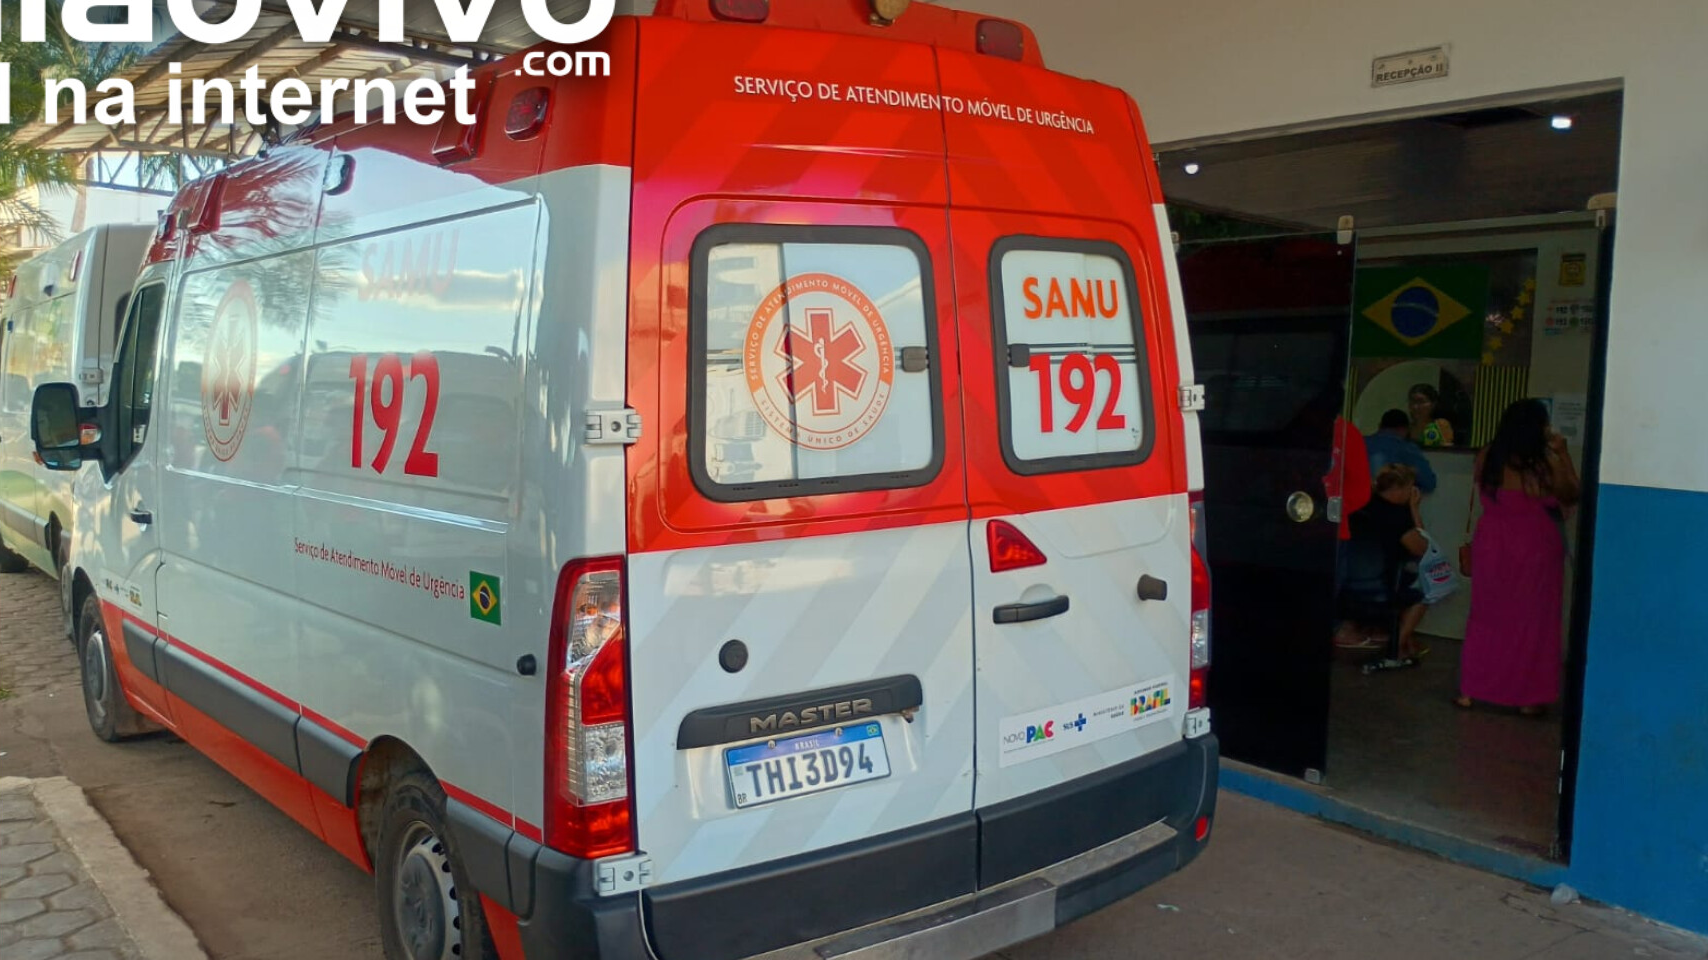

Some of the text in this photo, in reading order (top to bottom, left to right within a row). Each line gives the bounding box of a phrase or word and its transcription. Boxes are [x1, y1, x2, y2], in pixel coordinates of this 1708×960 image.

[1376, 64, 1432, 82] RECEPÇÃO
[734, 76, 1094, 135] SERVIÇO DE ATENDIMENTO MÓVEL DE URGÊNCIA
[358, 228, 460, 302] SAMU
[749, 332, 759, 381] SERVIÇO
[755, 315, 766, 328] DE
[863, 305, 874, 318] DE
[348, 350, 440, 478] 192
[1029, 351, 1126, 434] 192
[847, 428, 859, 438] DE
[294, 537, 465, 599] Serviço de Atendimento Móvel de Urgência
[750, 698, 873, 734] MASTER
[1129, 687, 1171, 717] BRASIL
[794, 737, 820, 751] BRASIL
[1003, 720, 1054, 745] NOVO PAC
[745, 742, 874, 798] THI3D94
